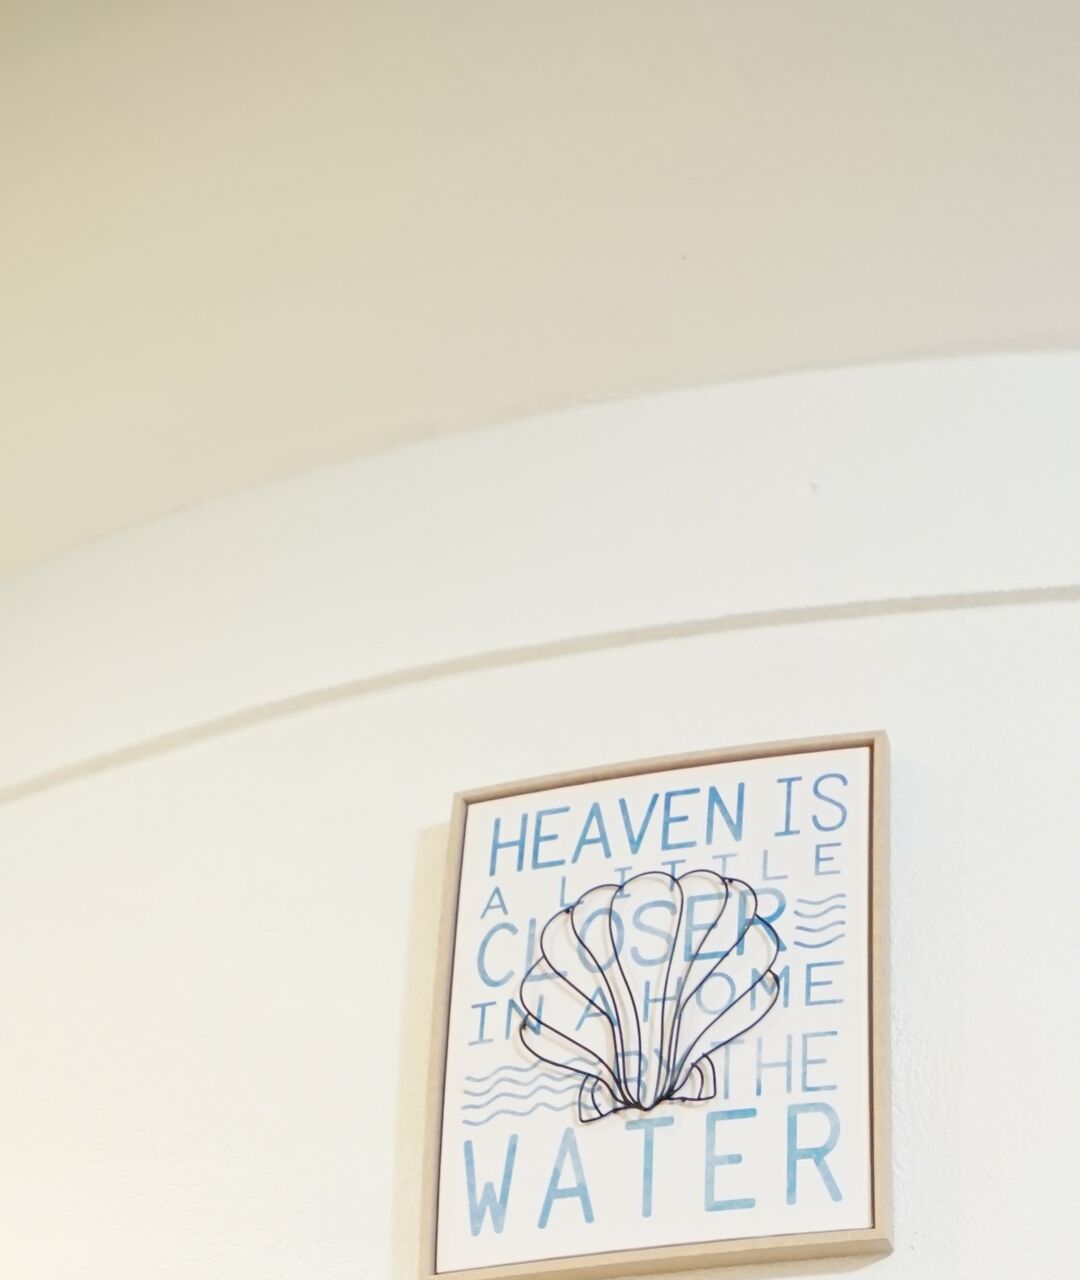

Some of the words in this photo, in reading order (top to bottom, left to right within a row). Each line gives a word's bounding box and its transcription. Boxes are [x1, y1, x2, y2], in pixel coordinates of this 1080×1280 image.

[488, 782, 746, 877] HEAVEN
[773, 772, 849, 837] IS
[480, 886, 508, 919] A
[559, 842, 842, 908] LITTLE
[476, 887, 788, 988] CLOSER
[467, 994, 544, 1046] IN
[575, 986, 618, 1031] A
[643, 961, 844, 1023] HOME
[710, 1030, 838, 1100] THE
[463, 1101, 844, 1237] WATER
